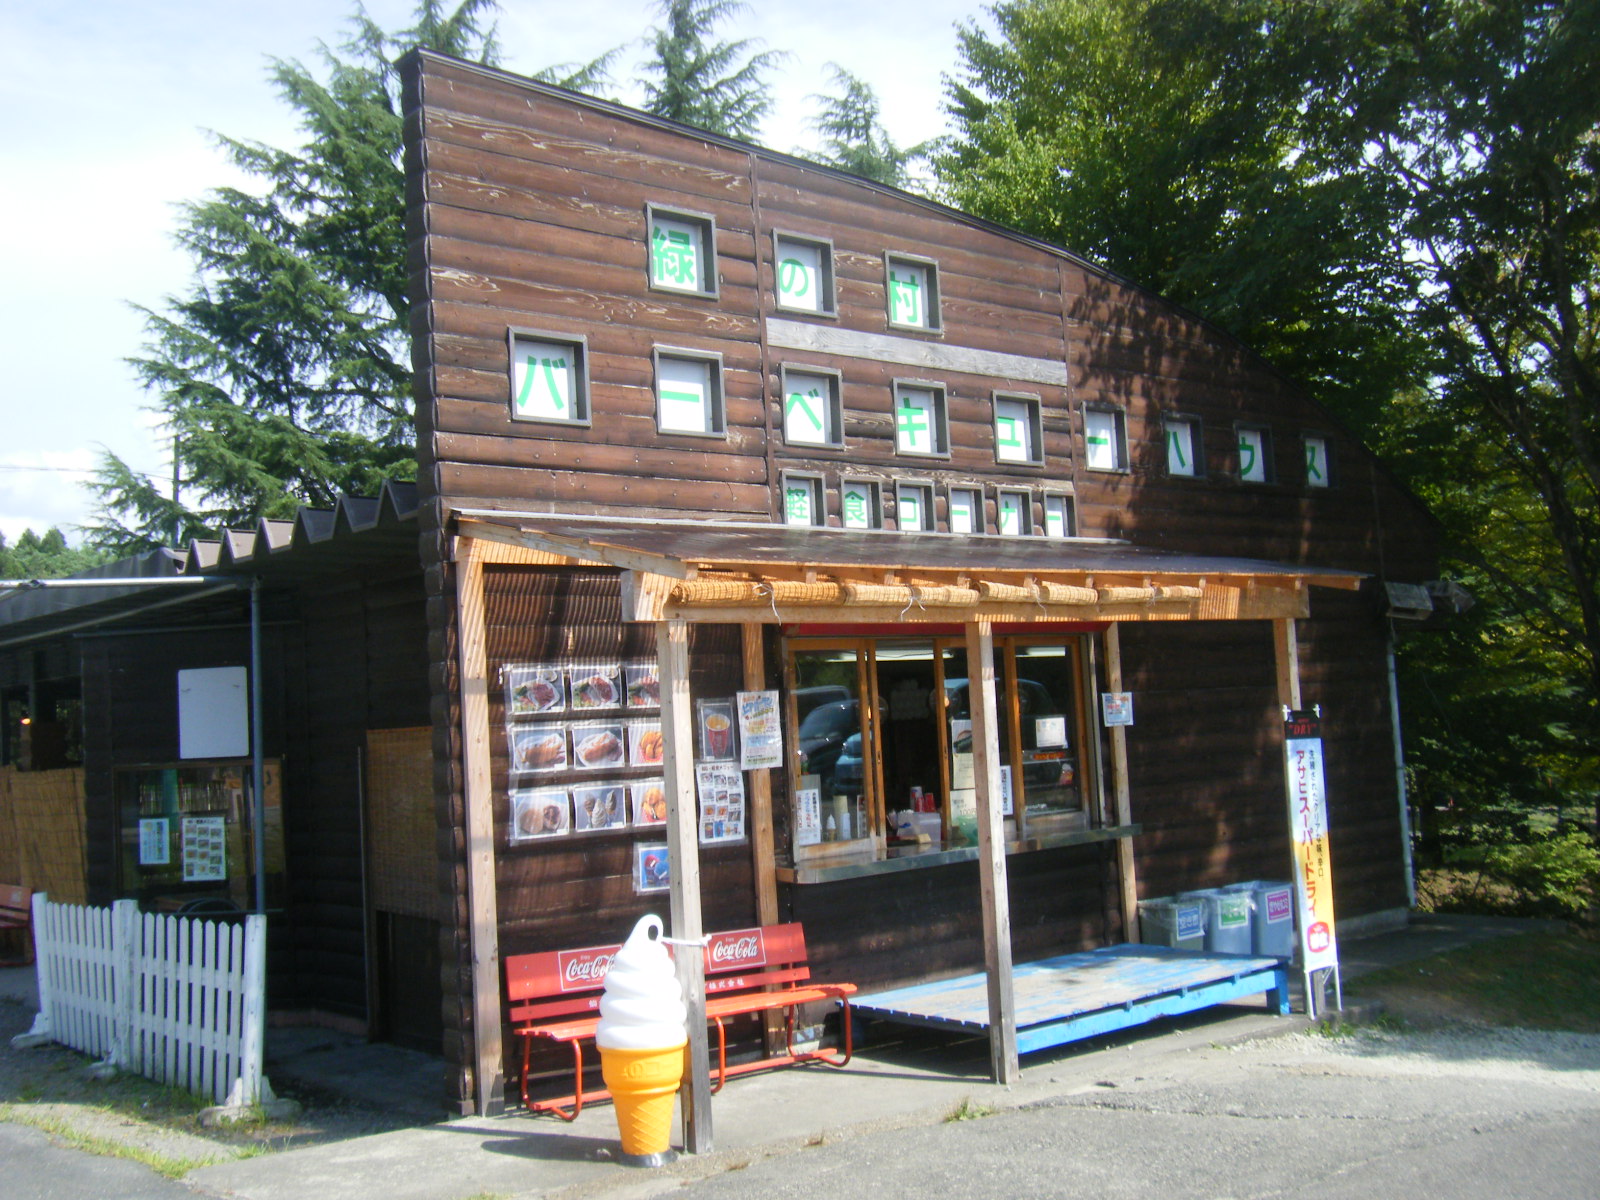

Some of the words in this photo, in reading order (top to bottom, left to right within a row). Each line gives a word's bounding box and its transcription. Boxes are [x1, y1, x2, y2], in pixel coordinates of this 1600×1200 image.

[652, 226, 918, 323] 緑の村
[517, 356, 1322, 480] バーベキューハウス
[786, 487, 1061, 528] 軽食コーナー
[1296, 750, 1316, 918] アサヒスーパードライ
[713, 936, 758, 962] Coca-Cola
